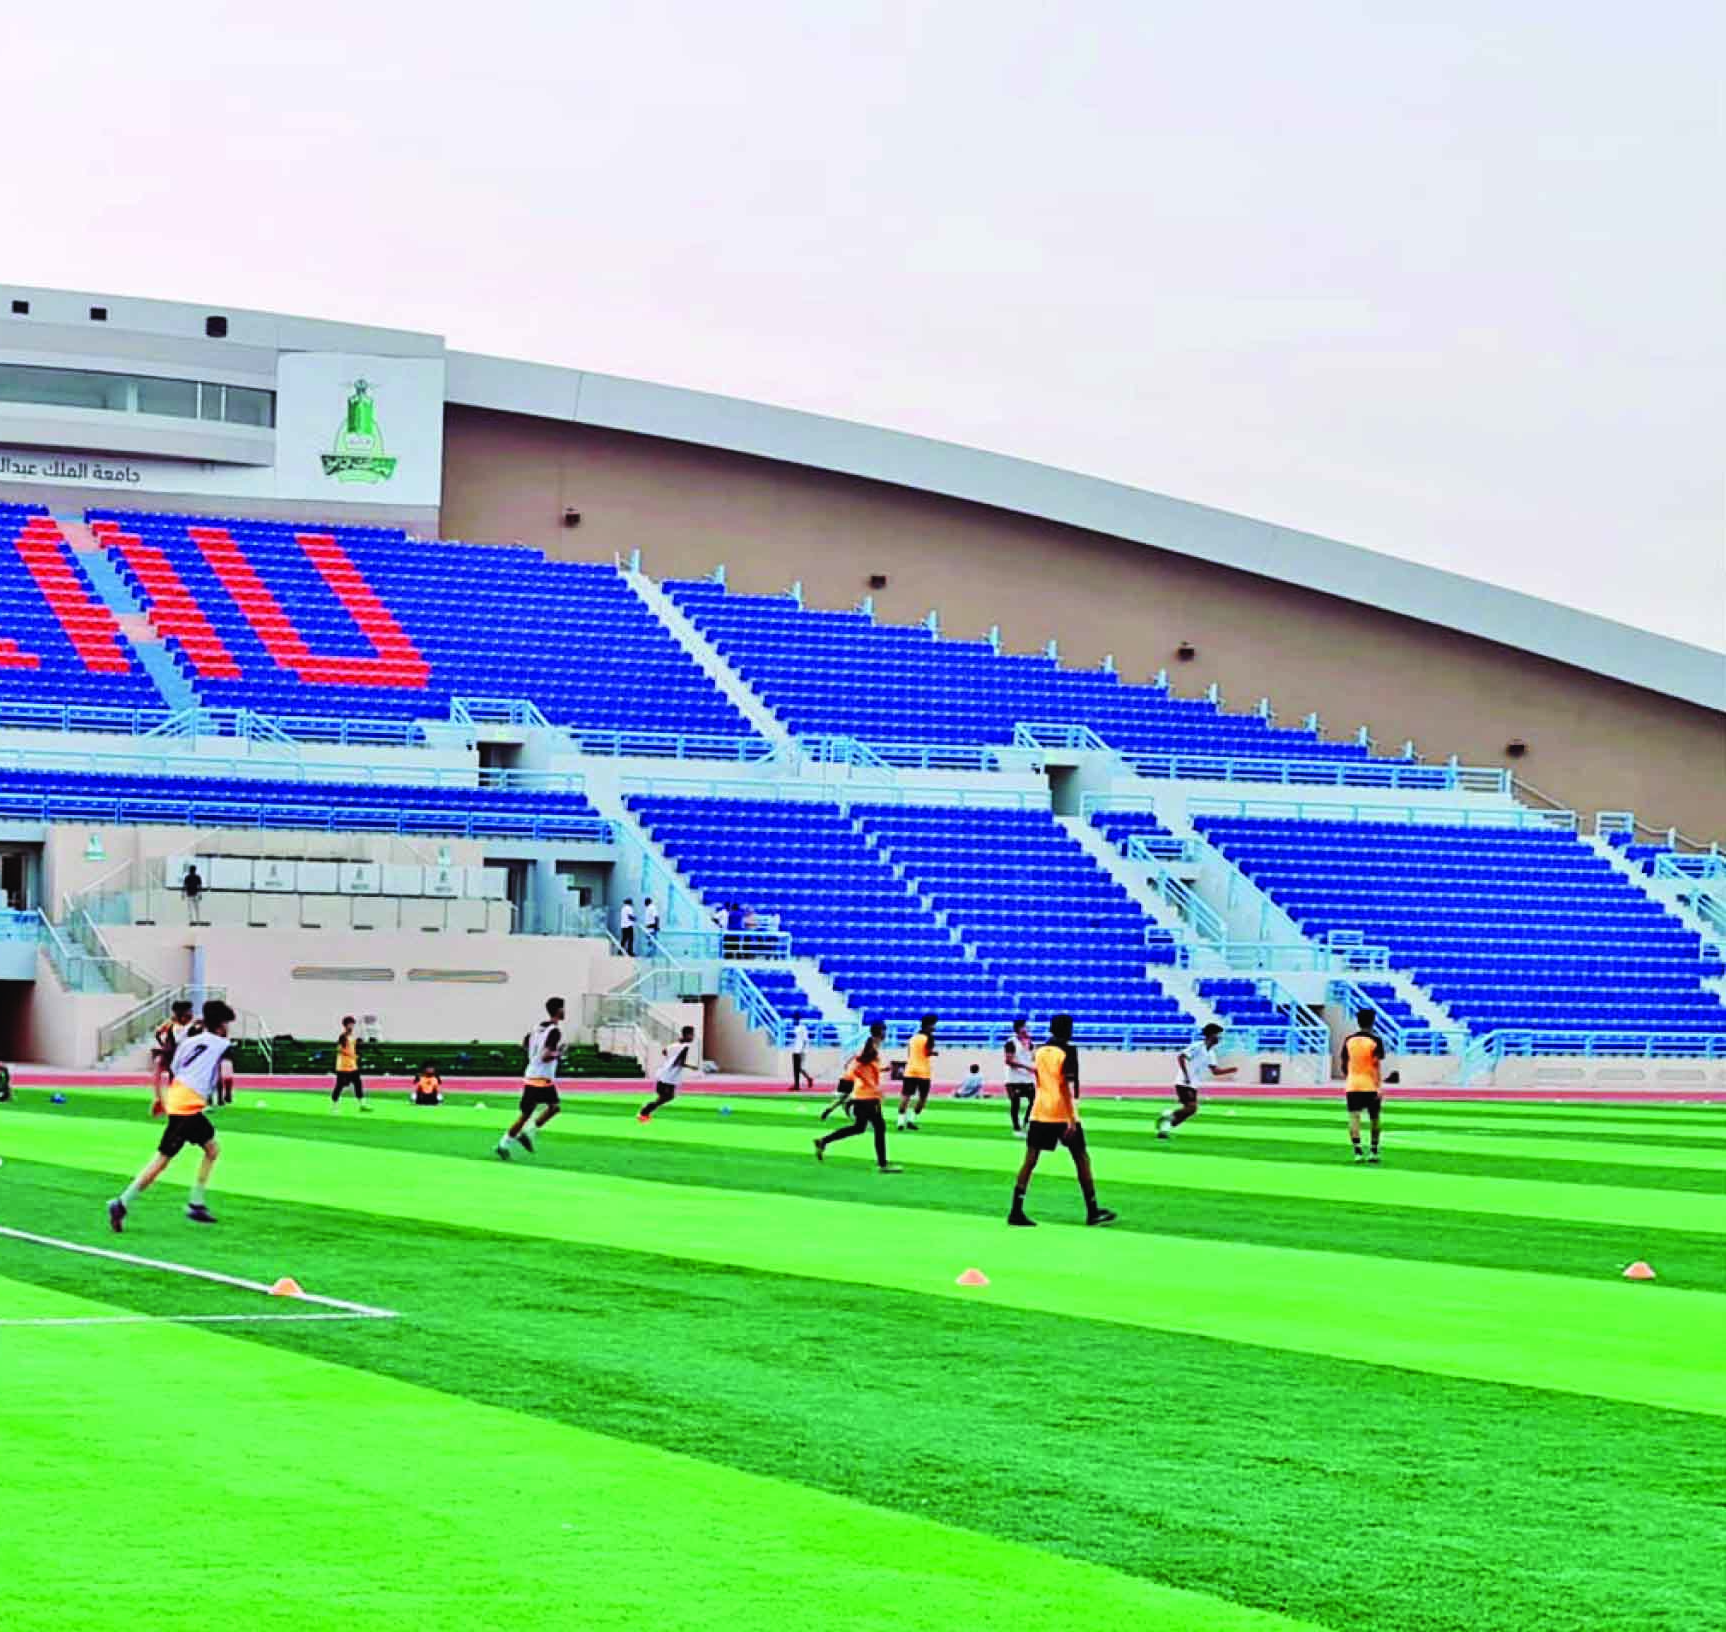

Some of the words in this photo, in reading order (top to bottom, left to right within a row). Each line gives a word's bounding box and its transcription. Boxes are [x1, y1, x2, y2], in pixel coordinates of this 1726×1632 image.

[41, 459, 88, 479] الملك
[92, 463, 141, 483] جامعة
[183, 1045, 208, 1067] 7
